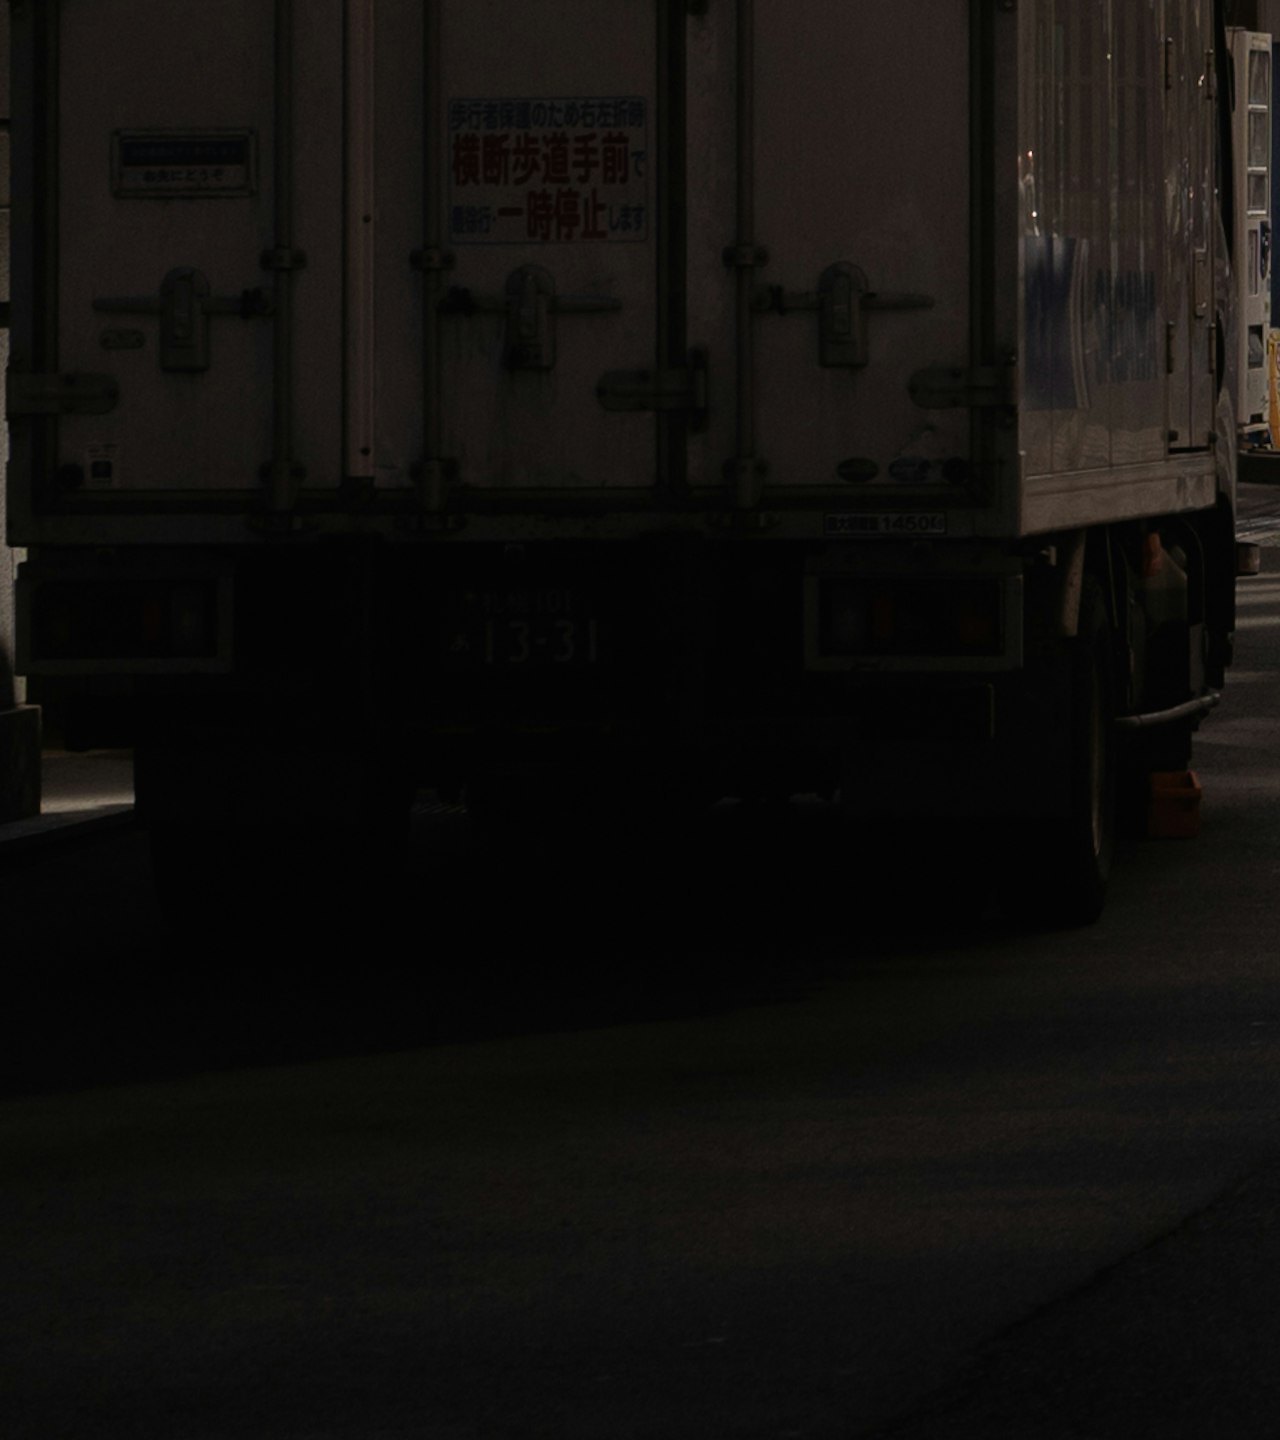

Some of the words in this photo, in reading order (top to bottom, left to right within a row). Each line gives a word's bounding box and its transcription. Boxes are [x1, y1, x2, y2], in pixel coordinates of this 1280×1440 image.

[451, 101, 645, 129] 歩行者保護のため右左折時
[452, 131, 647, 187] 横断歩道手前で
